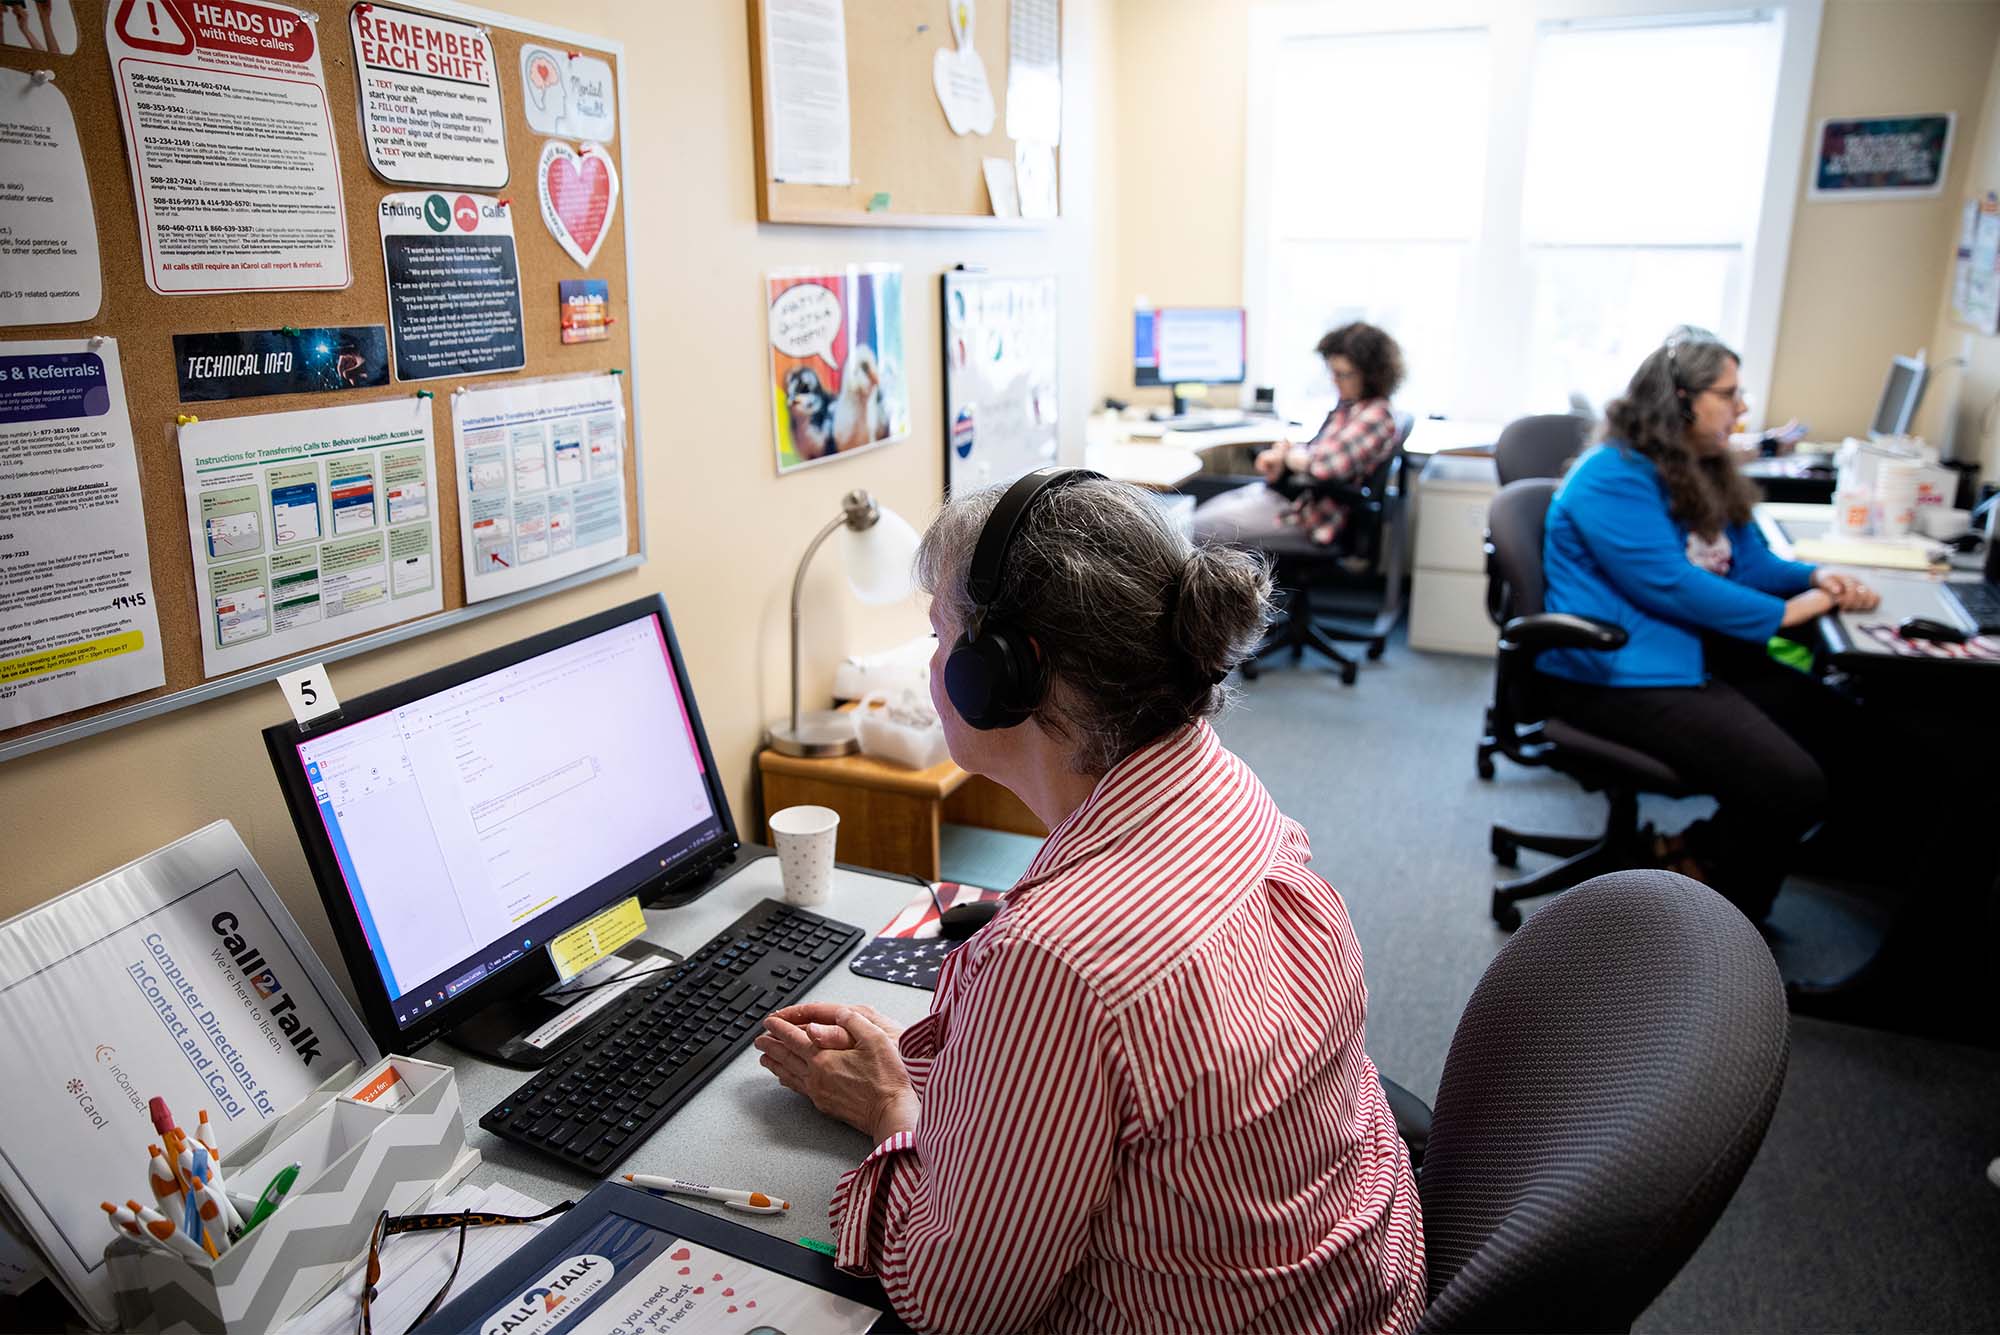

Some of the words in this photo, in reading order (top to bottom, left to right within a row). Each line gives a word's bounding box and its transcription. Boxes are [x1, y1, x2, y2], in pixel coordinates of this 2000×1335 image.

[193, 3, 265, 34] HEADS
[268, 17, 294, 38] UP
[199, 27, 226, 41] with
[228, 31, 258, 46] these
[261, 38, 295, 52] callers
[356, 15, 486, 62] REMEMBER
[361, 41, 419, 70] EACH
[425, 53, 490, 82] SHIFT:
[131, 73, 178, 85] 508-405-6511
[186, 80, 231, 91] 774-602-6744
[376, 80, 392, 89] TEXT
[394, 83, 409, 92] your
[410, 85, 425, 94] shift
[426, 87, 457, 98] supervisor
[459, 93, 475, 101] when
[369, 90, 384, 99] start
[387, 94, 401, 102] your
[403, 95, 417, 104] shift
[137, 102, 184, 113] 508-353-9342
[370, 101, 377, 109] 2.
[378, 102, 392, 112] FILL
[394, 104, 408, 113] OUT
[417, 108, 427, 117] put
[430, 109, 449, 119] yellow
[450, 112, 463, 121] shift
[371, 113, 387, 121] form
[397, 116, 407, 124] the
[409, 117, 429, 126] binder
[431, 119, 441, 129] (by
[144, 136, 190, 146] 413-234-2149
[372, 124, 379, 133] 3.
[380, 125, 390, 134] DO
[392, 127, 406, 135] NOT
[408, 128, 421, 138] sign
[423, 130, 433, 138] out
[435, 131, 441, 139] of
[442, 132, 452, 141] the
[454, 134, 482, 144] computer
[373, 137, 388, 145] your
[390, 137, 405, 146] shift
[377, 158, 396, 167] leave
[383, 147, 400, 156] TEXT
[401, 151, 416, 159] your
[418, 151, 432, 160] shift
[433, 152, 464, 162] supervisor
[150, 176, 196, 185] 508-282-7424
[153, 198, 199, 206] 508-816-9973
[381, 203, 422, 220] Ending
[482, 205, 506, 218] Calls
[157, 224, 202, 232] 860-460-0711
[32, 239, 59, 247] pantries
[205, 263, 230, 271] require
[273, 262, 291, 270] report
[11, 367, 25, 380] &
[27, 363, 100, 380] Referrals:
[188, 354, 261, 380] TECHNICAL
[264, 351, 293, 375] INFO
[195, 453, 244, 466] Instructions
[245, 451, 257, 461] for
[257, 445, 303, 459] Transferring
[303, 442, 320, 452] Calls
[321, 441, 332, 449] to:
[333, 434, 367, 448] Behavioral
[368, 432, 389, 442] Health
[390, 429, 410, 439] Access
[411, 428, 424, 436] Line
[112, 592, 147, 610] 4945
[301, 680, 317, 705] 5
[211, 948, 236, 982] We're
[232, 977, 253, 1008] here
[250, 1005, 261, 1022] to
[259, 1018, 282, 1055] listen.
[146, 933, 204, 1010] Computer
[200, 1010, 257, 1091] Directions
[254, 1088, 275, 1115] for
[130, 959, 189, 1039] inContact
[183, 1039, 213, 1071] and
[205, 1068, 246, 1119] iCarol
[110, 1064, 148, 1113] inContact
[76, 1090, 109, 1130] iCarol
[622, 1308, 645, 1328] you
[643, 1285, 670, 1309] need
[645, 1304, 669, 1327] your
[666, 1282, 694, 1304] best
[656, 1323, 671, 1335] in
[667, 1299, 697, 1324] here!
